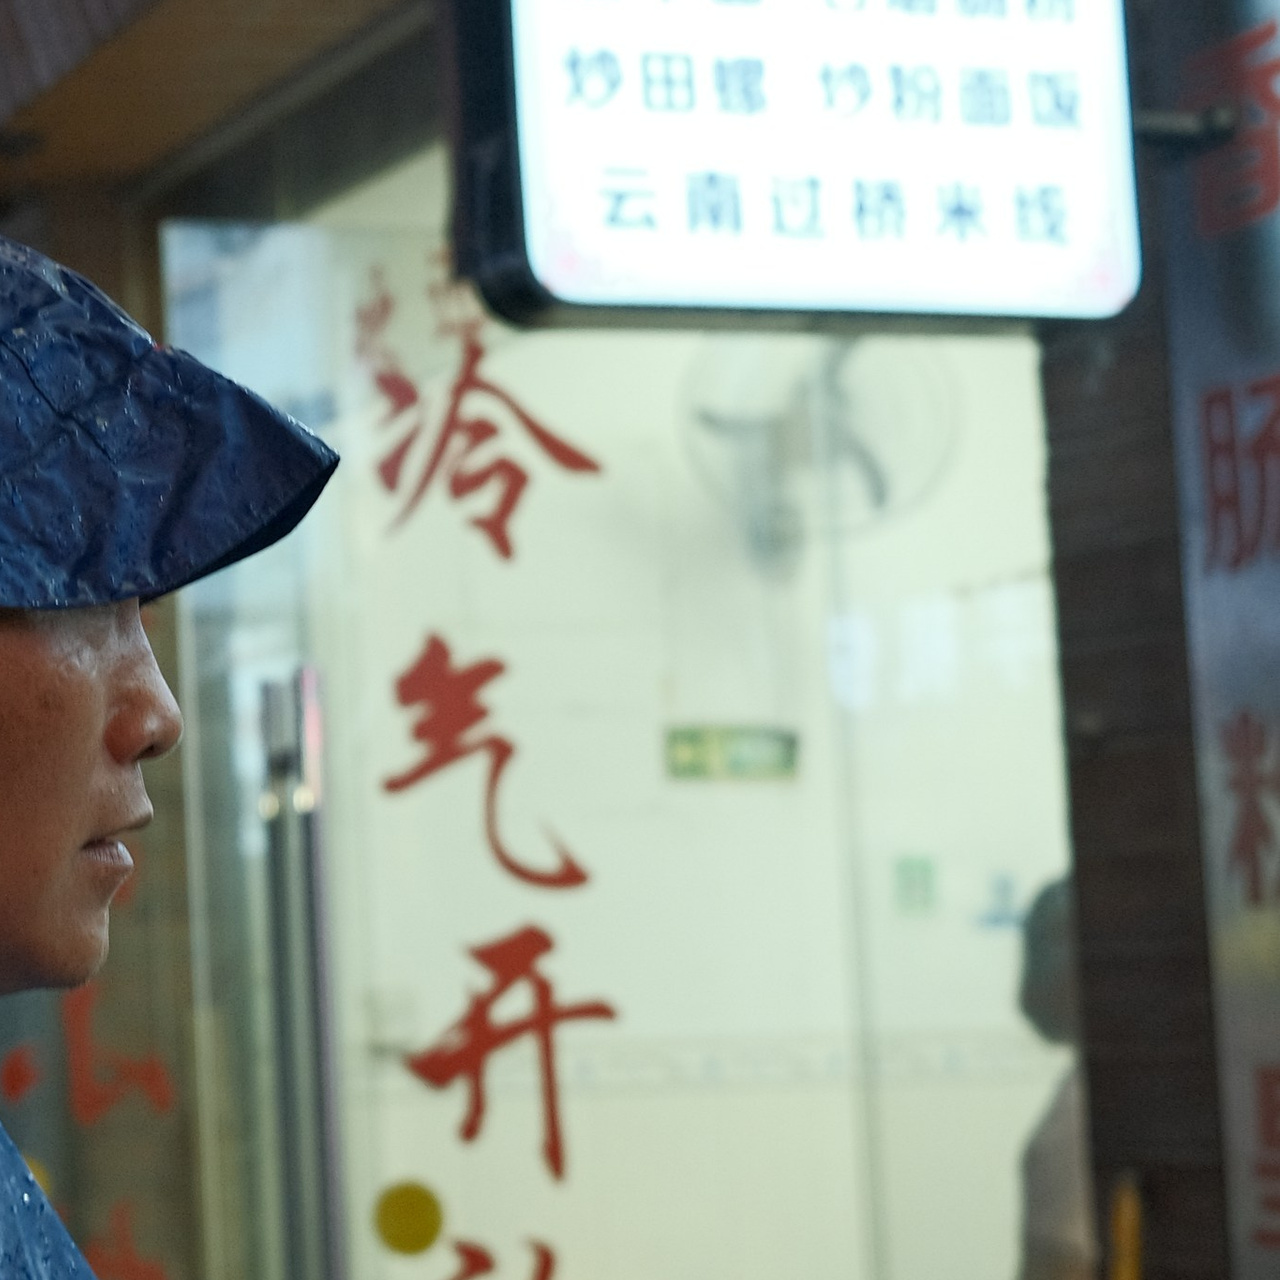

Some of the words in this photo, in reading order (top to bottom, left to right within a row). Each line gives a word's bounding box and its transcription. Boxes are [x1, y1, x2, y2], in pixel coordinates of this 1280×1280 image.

[562, 46, 768, 116] 炒田螺
[818, 60, 1081, 131] 炒粉面饭
[597, 166, 1071, 247] 云南过桥米线
